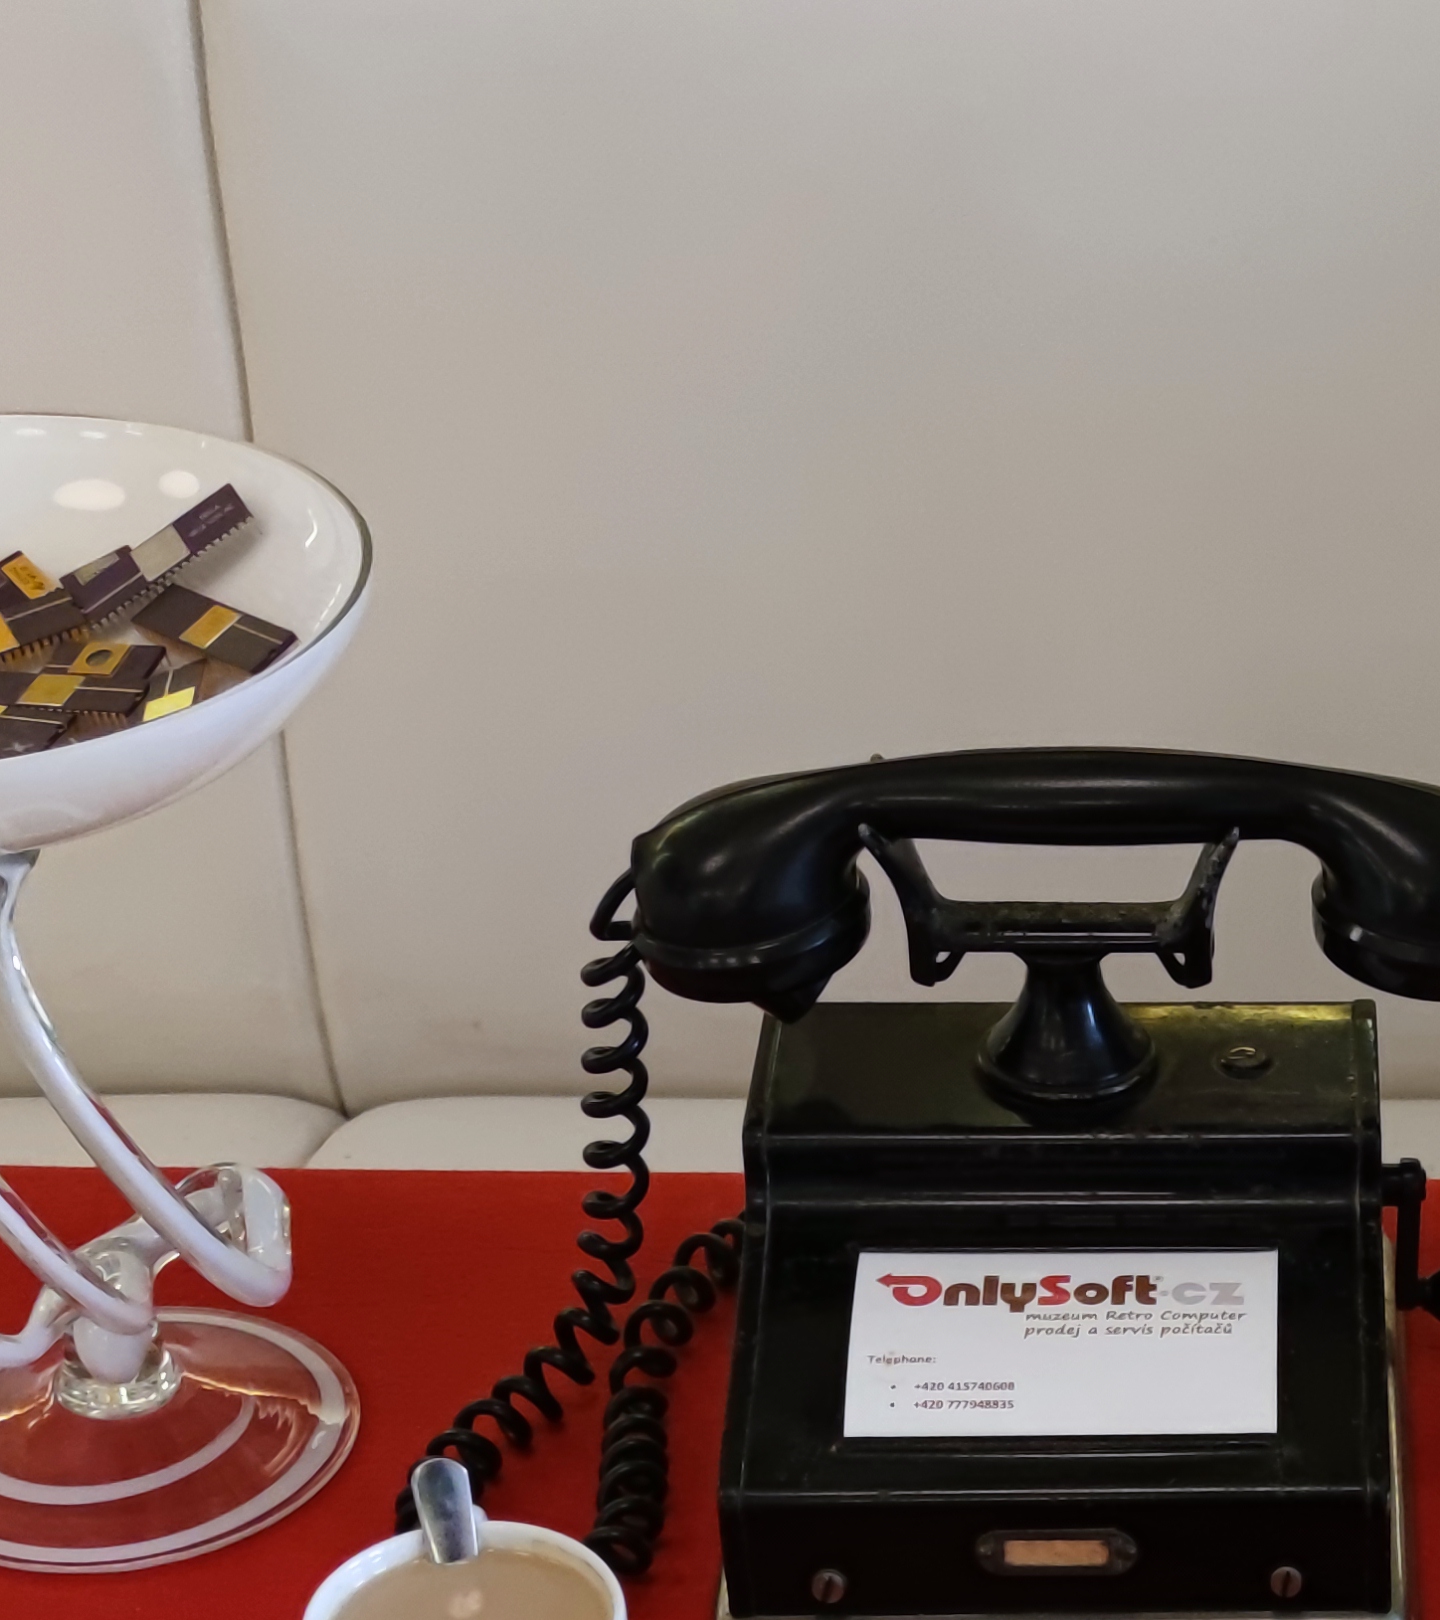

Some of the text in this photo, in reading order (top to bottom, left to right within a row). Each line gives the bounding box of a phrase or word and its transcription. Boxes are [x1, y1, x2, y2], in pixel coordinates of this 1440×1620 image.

[1026, 1311, 1247, 1323] muzeum Retro Computer
[1024, 1324, 1080, 1338] prodej
[1088, 1327, 1097, 1335] a
[1105, 1324, 1153, 1335] servis
